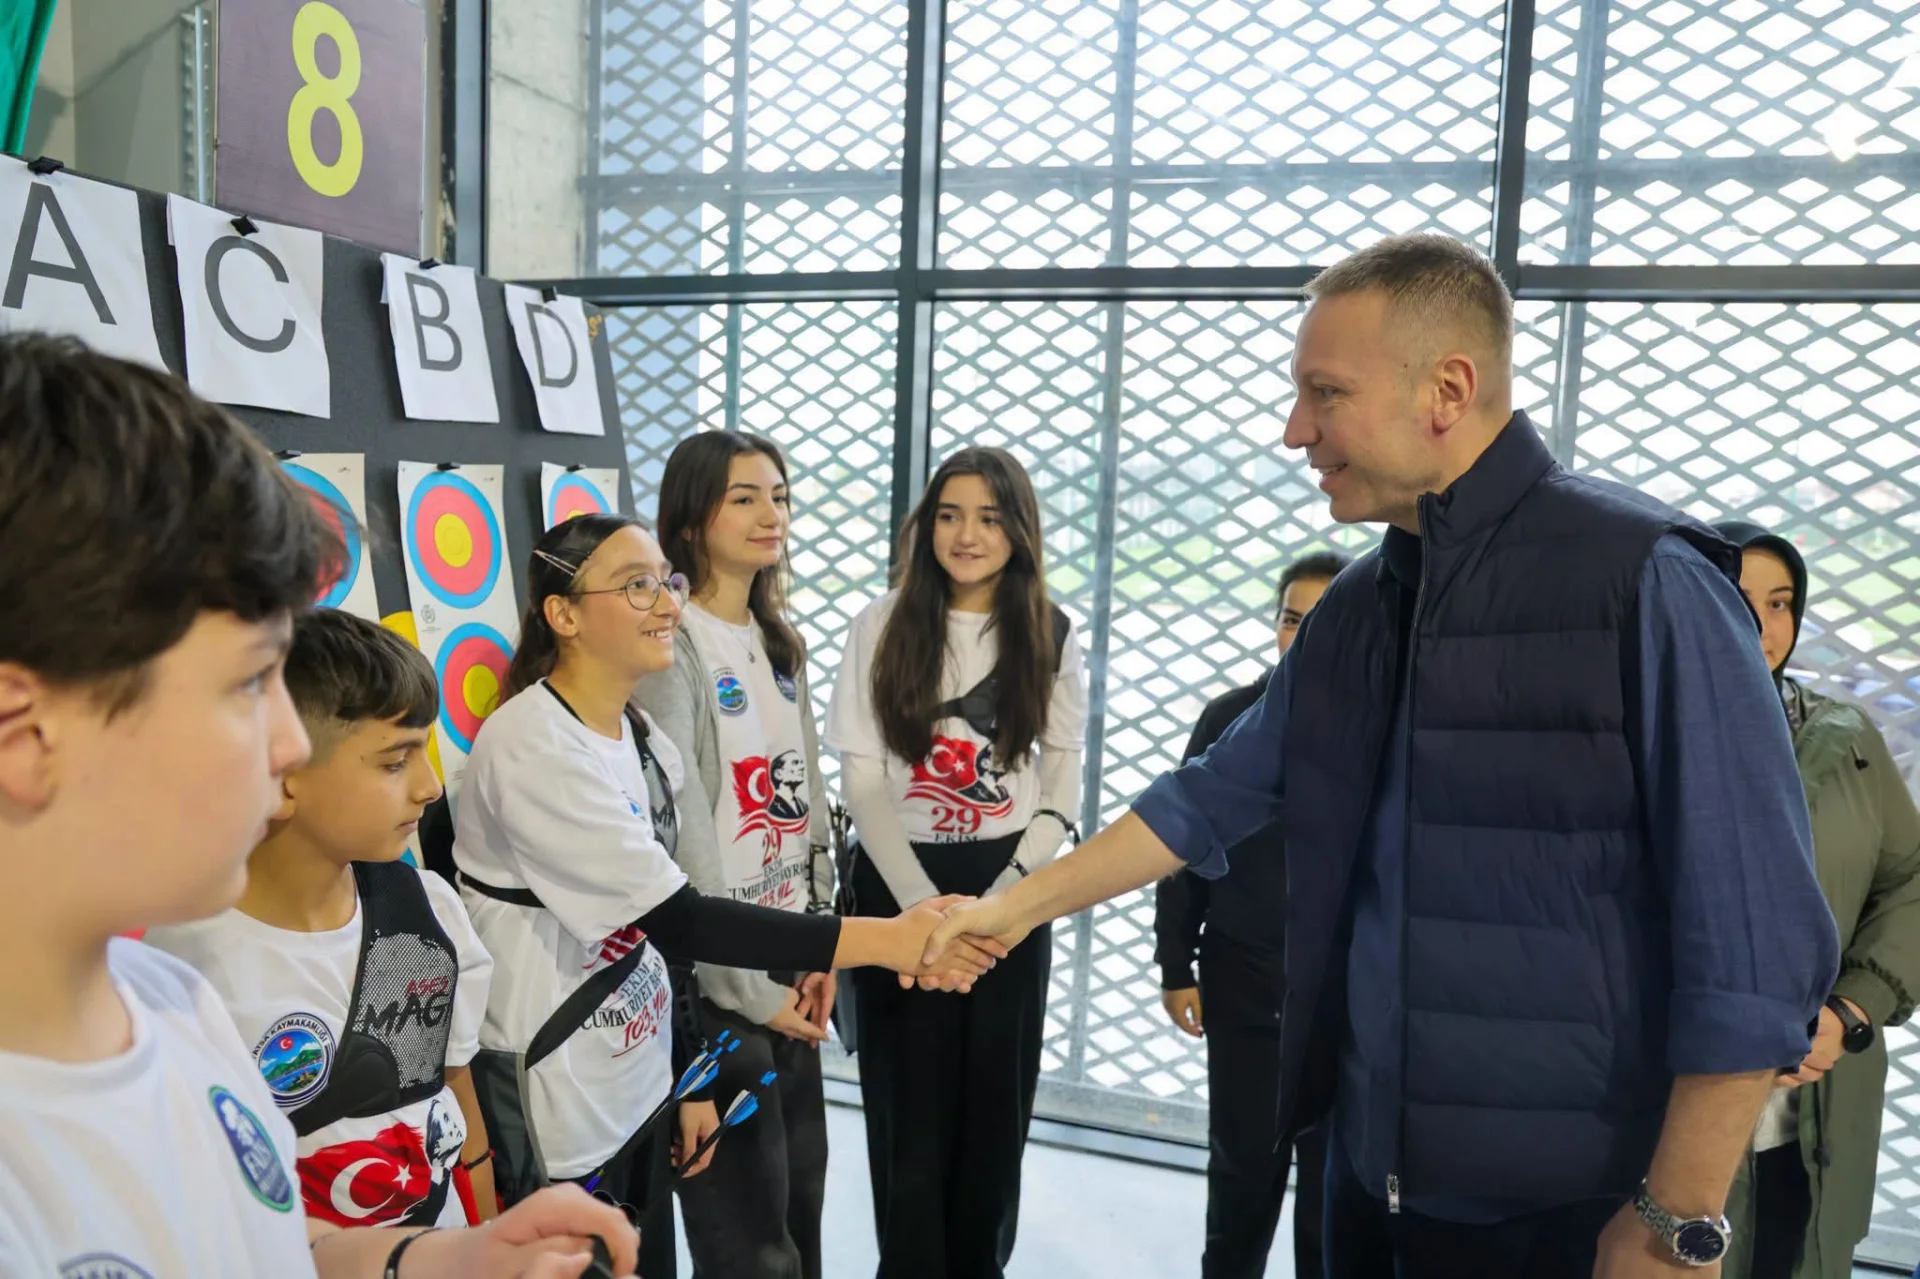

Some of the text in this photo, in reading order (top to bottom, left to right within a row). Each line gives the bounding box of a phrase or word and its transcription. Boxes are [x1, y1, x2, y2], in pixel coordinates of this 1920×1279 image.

[287, 0, 363, 197] 8
[2, 181, 118, 326] A
[204, 235, 296, 353] C
[404, 271, 463, 373] B
[526, 303, 579, 389] D
[762, 827, 782, 867] 29
[931, 806, 982, 834] 29
